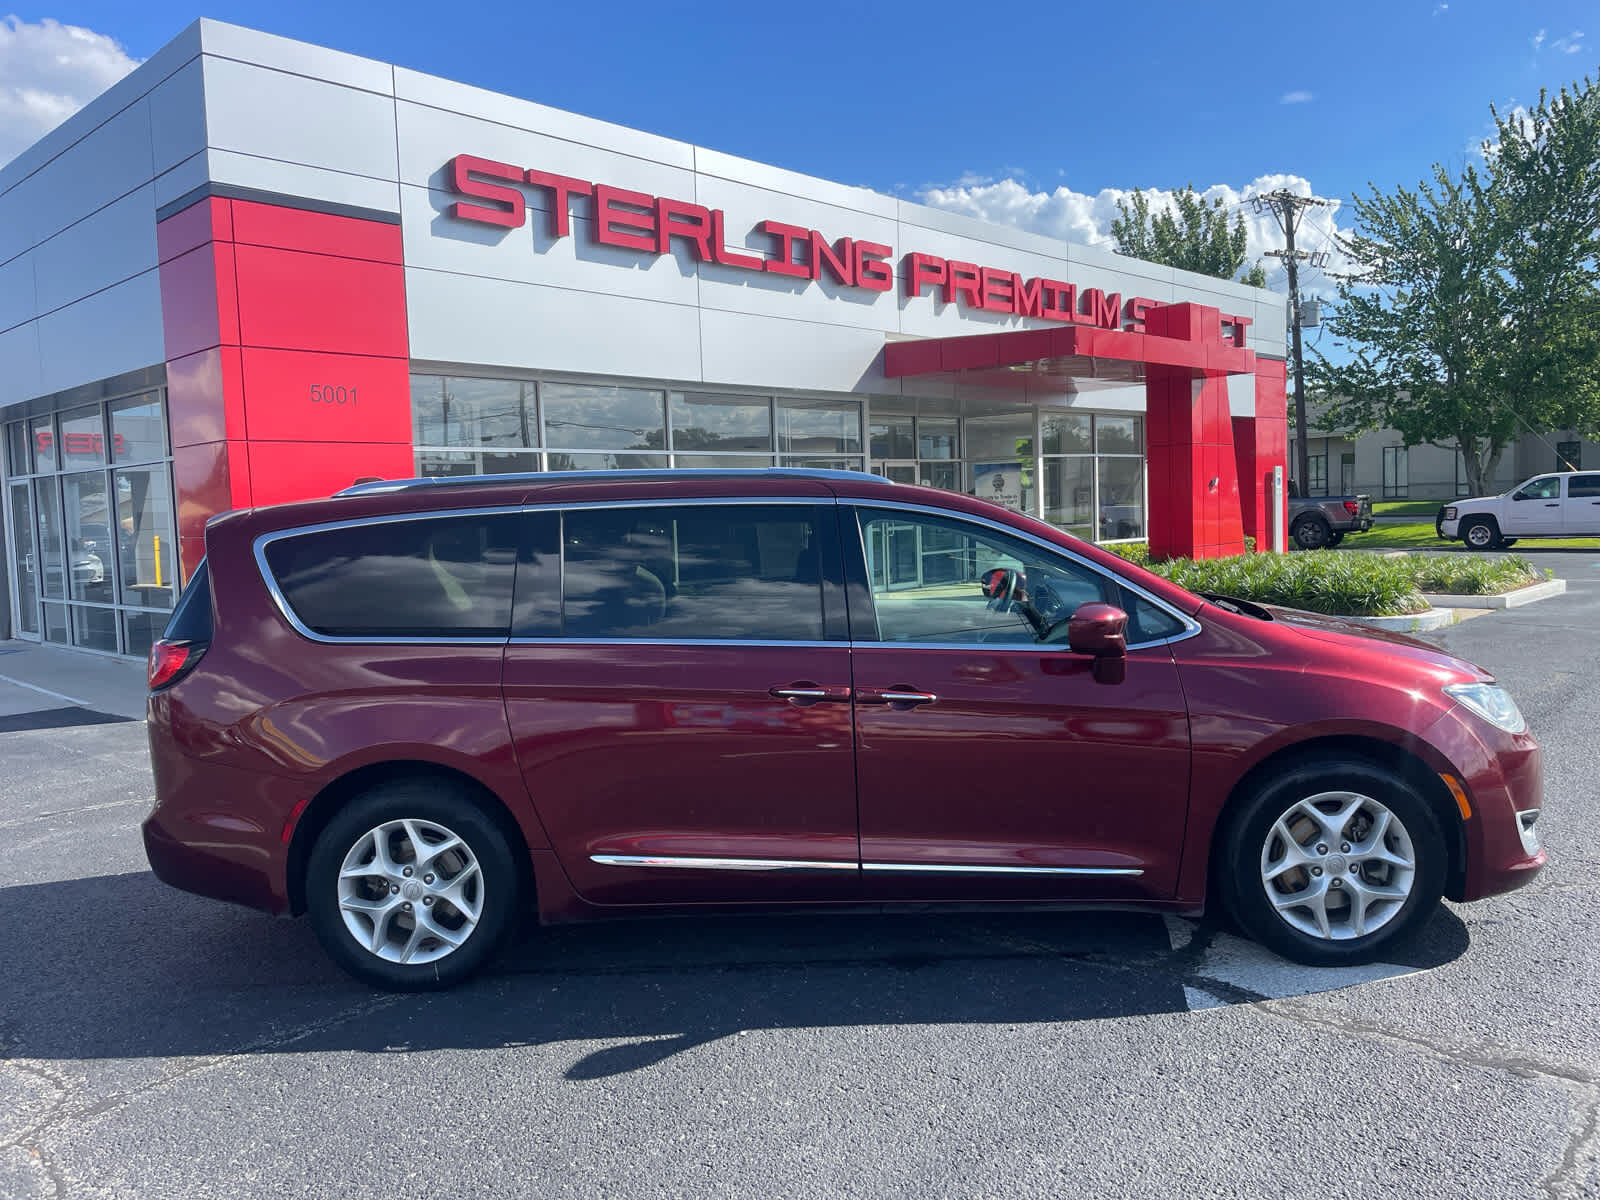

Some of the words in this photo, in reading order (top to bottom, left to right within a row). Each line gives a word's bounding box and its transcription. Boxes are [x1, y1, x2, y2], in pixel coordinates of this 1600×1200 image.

[450, 153, 893, 291] STERLING
[905, 252, 1122, 330] PREMIUM
[1127, 296, 1253, 348] SCT
[310, 384, 357, 405] 5001
